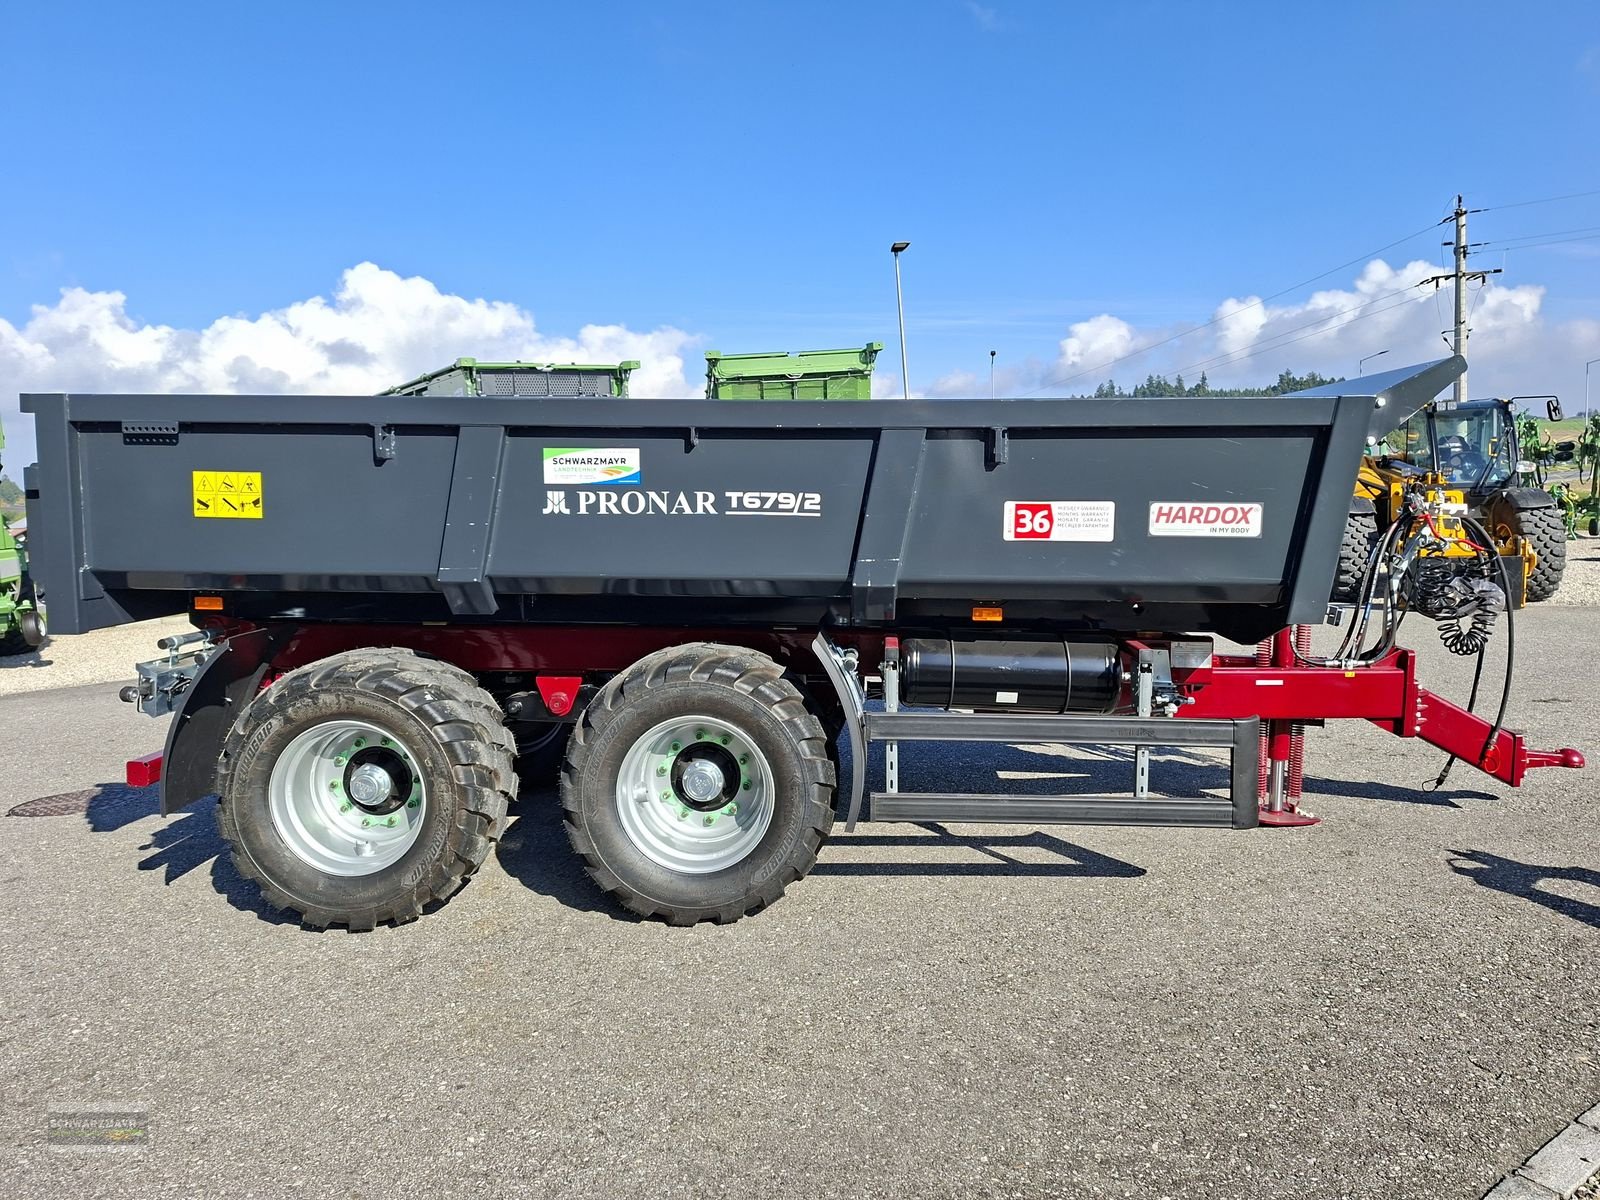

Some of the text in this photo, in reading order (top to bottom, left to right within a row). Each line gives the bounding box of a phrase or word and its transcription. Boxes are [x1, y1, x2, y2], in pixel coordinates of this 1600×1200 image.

[552, 457, 627, 465] SCHWARZMAYR
[576, 491, 821, 515] PRONAR T679/2
[1016, 509, 1050, 533] 36
[1155, 506, 1254, 525] HARDOX
